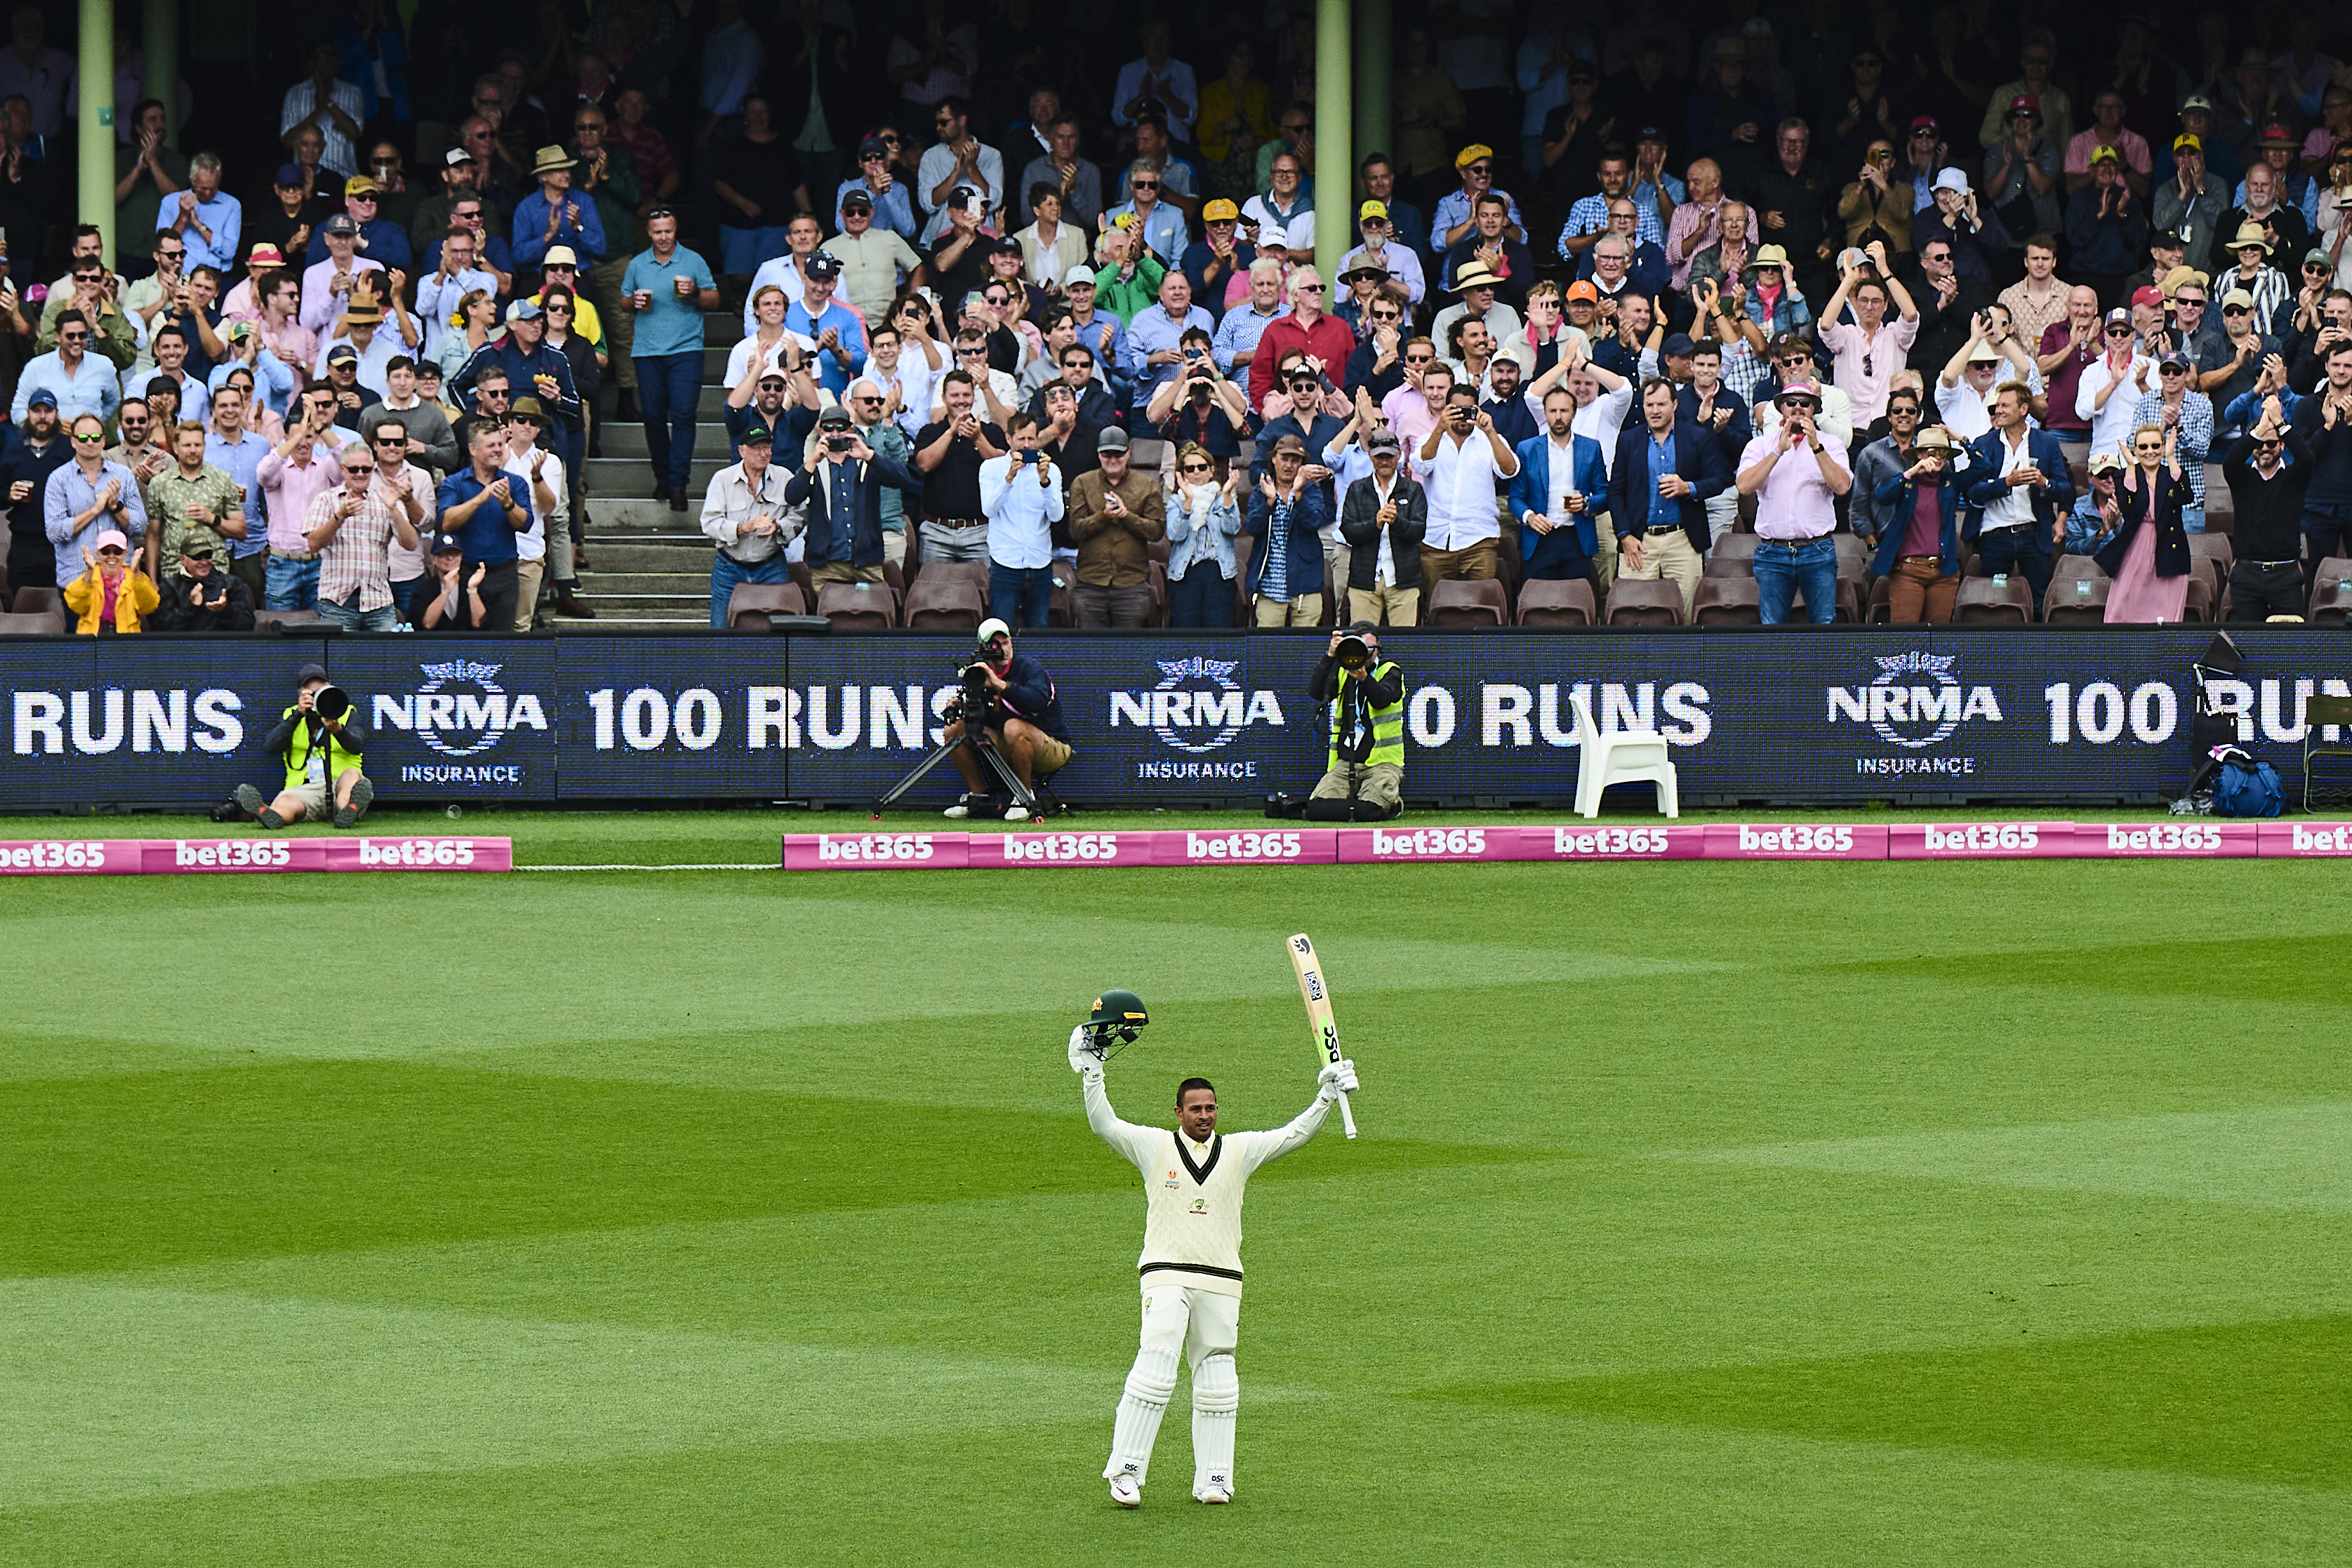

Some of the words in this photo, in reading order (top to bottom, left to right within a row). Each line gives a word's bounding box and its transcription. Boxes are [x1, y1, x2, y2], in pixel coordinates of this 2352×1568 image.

[373, 694, 547, 731] NRMA
[1110, 691, 1286, 727] NRMA
[1481, 682, 1713, 748] RUNS
[1827, 686, 2002, 723] NRMA
[2044, 682, 2177, 744] 100
[13, 690, 244, 755] RUNS
[588, 687, 723, 750] 100
[401, 766, 519, 783] INSURANCE
[1138, 762, 1257, 779] INSURANCE
[1856, 757, 1974, 774] INSURANCE
[819, 835, 934, 860] bet365
[1004, 834, 1117, 859] bet365
[1187, 832, 1301, 858] bet365
[1373, 829, 1486, 855] bet365
[1555, 828, 1669, 853] bet365
[1739, 825, 1853, 851] bet365
[1925, 824, 2039, 850] bet365
[2107, 824, 2222, 850] bet365
[2293, 824, 2352, 851] bet
[176, 841, 291, 867] bet365
[359, 840, 474, 865] bet365
[1308, 973, 1322, 998] BOND
[1324, 1025, 1340, 1063] DSC
[1124, 1463, 1138, 1472] DSC
